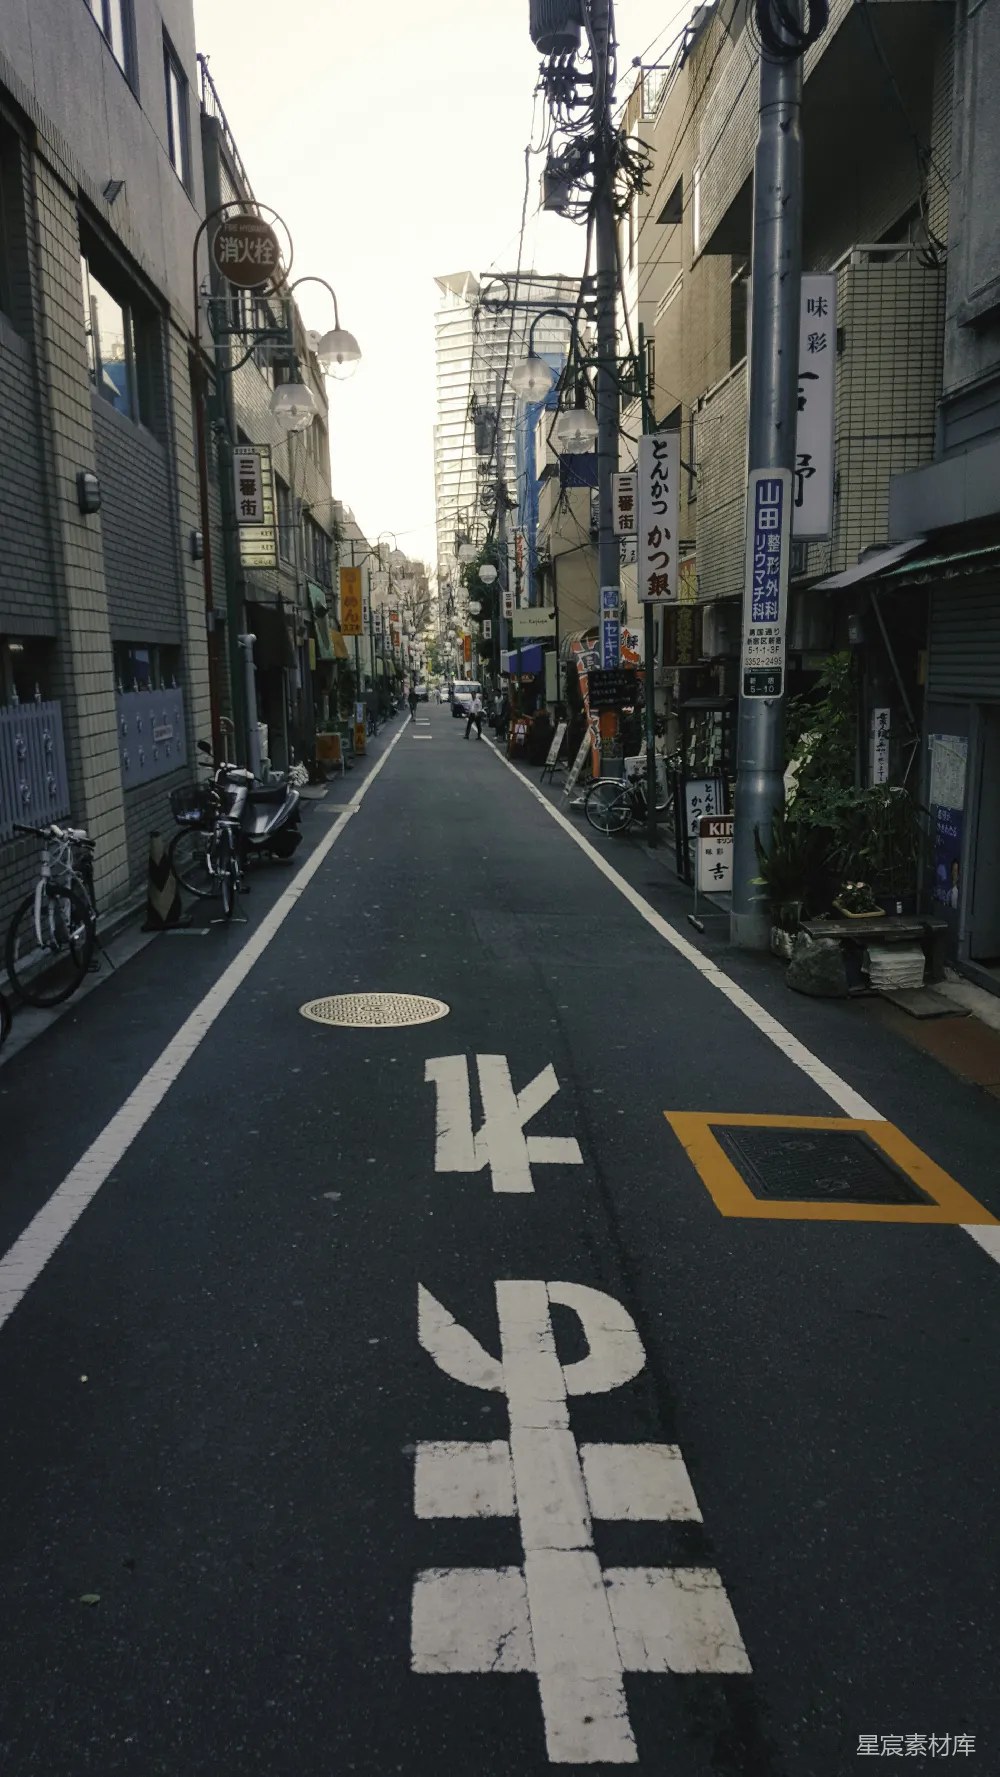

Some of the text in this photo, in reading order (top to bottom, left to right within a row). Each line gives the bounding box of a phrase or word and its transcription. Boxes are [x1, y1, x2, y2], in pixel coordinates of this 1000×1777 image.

[219, 236, 275, 265] 消火栓
[806, 296, 829, 354] 味彩
[239, 459, 257, 516] 三番街
[618, 477, 634, 530] 三番街
[758, 482, 780, 530] 山田
[646, 439, 672, 597] とんかつ かつ銀
[752, 534, 767, 621] リウマチ科
[765, 534, 781, 620] 整形外科
[748, 646, 780, 655] 5-1-1-3F
[750, 685, 775, 693] 5-10
[708, 862, 729, 881] 吉
